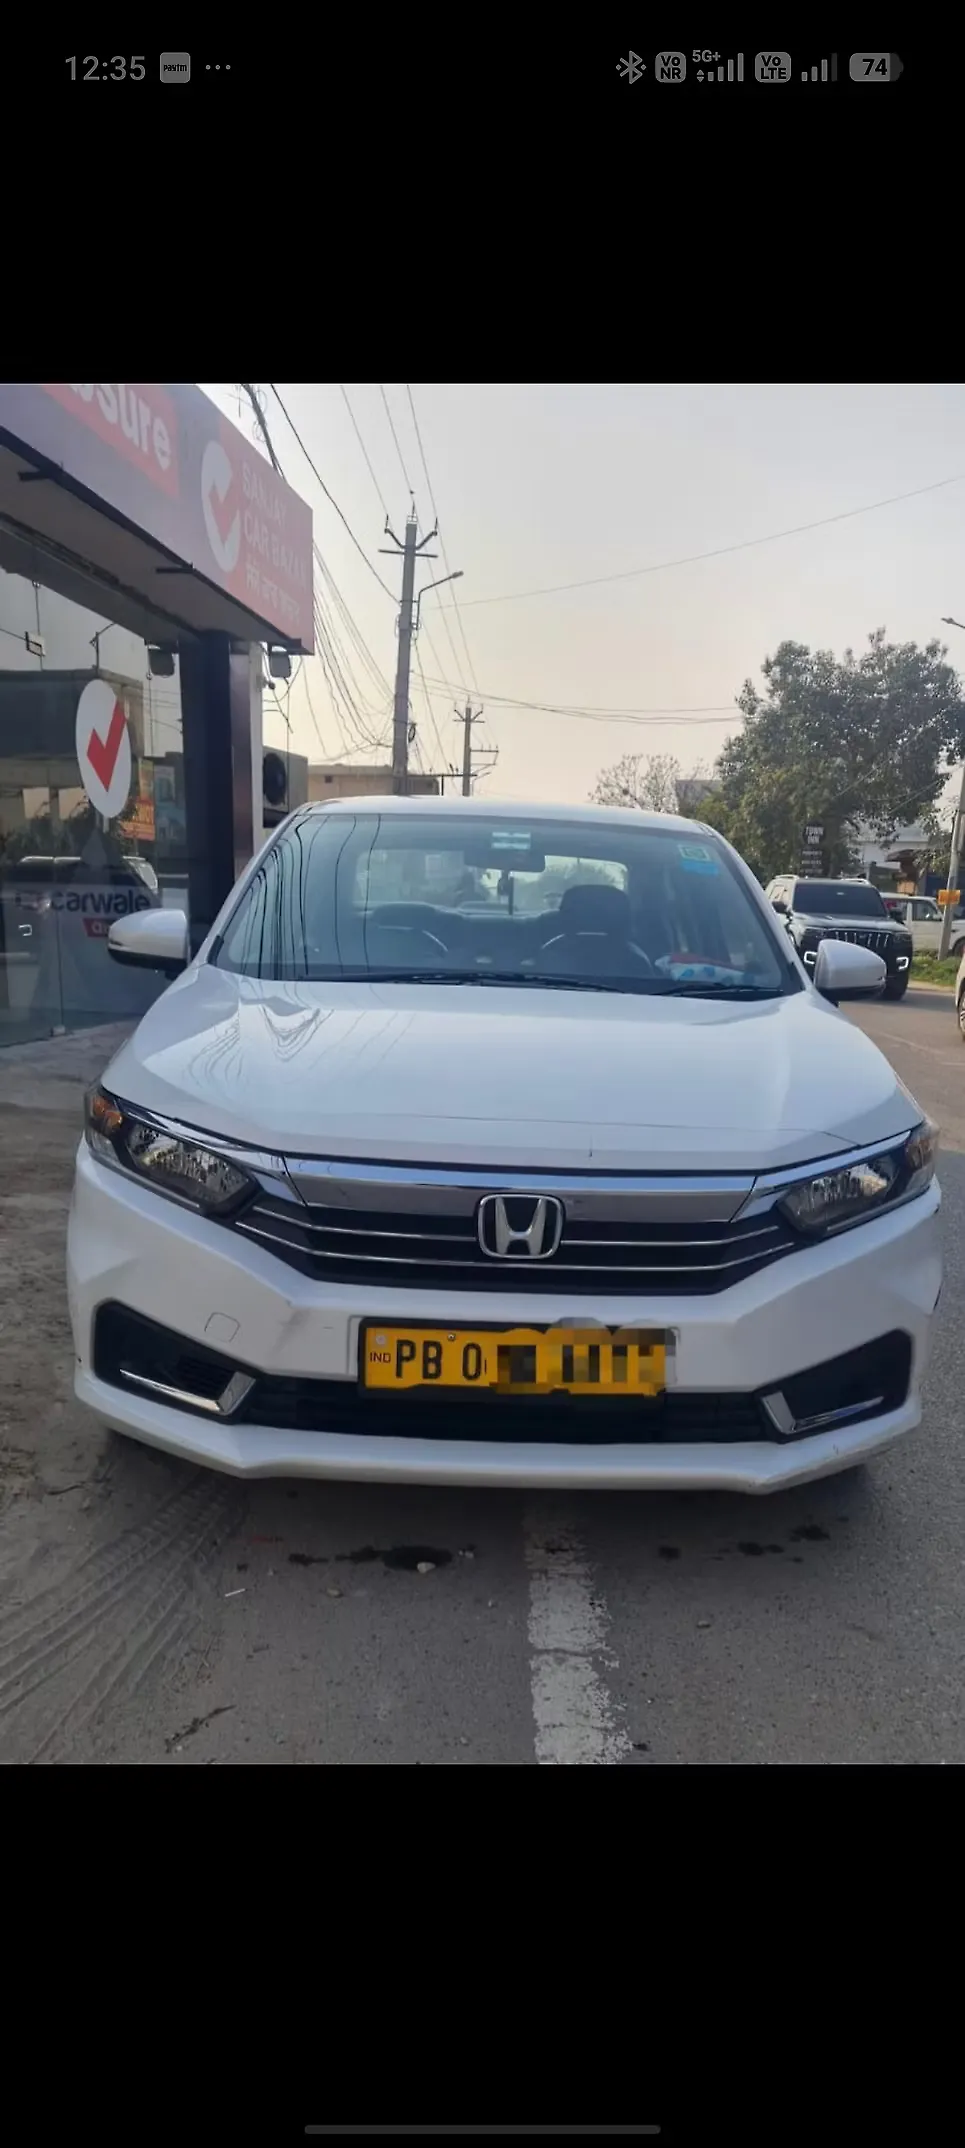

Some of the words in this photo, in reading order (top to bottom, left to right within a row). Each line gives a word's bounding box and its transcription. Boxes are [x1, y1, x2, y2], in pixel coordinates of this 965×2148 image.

[244, 510, 270, 561] CAR
[369, 1352, 391, 1364] IND
[396, 1339, 442, 1381] PB
